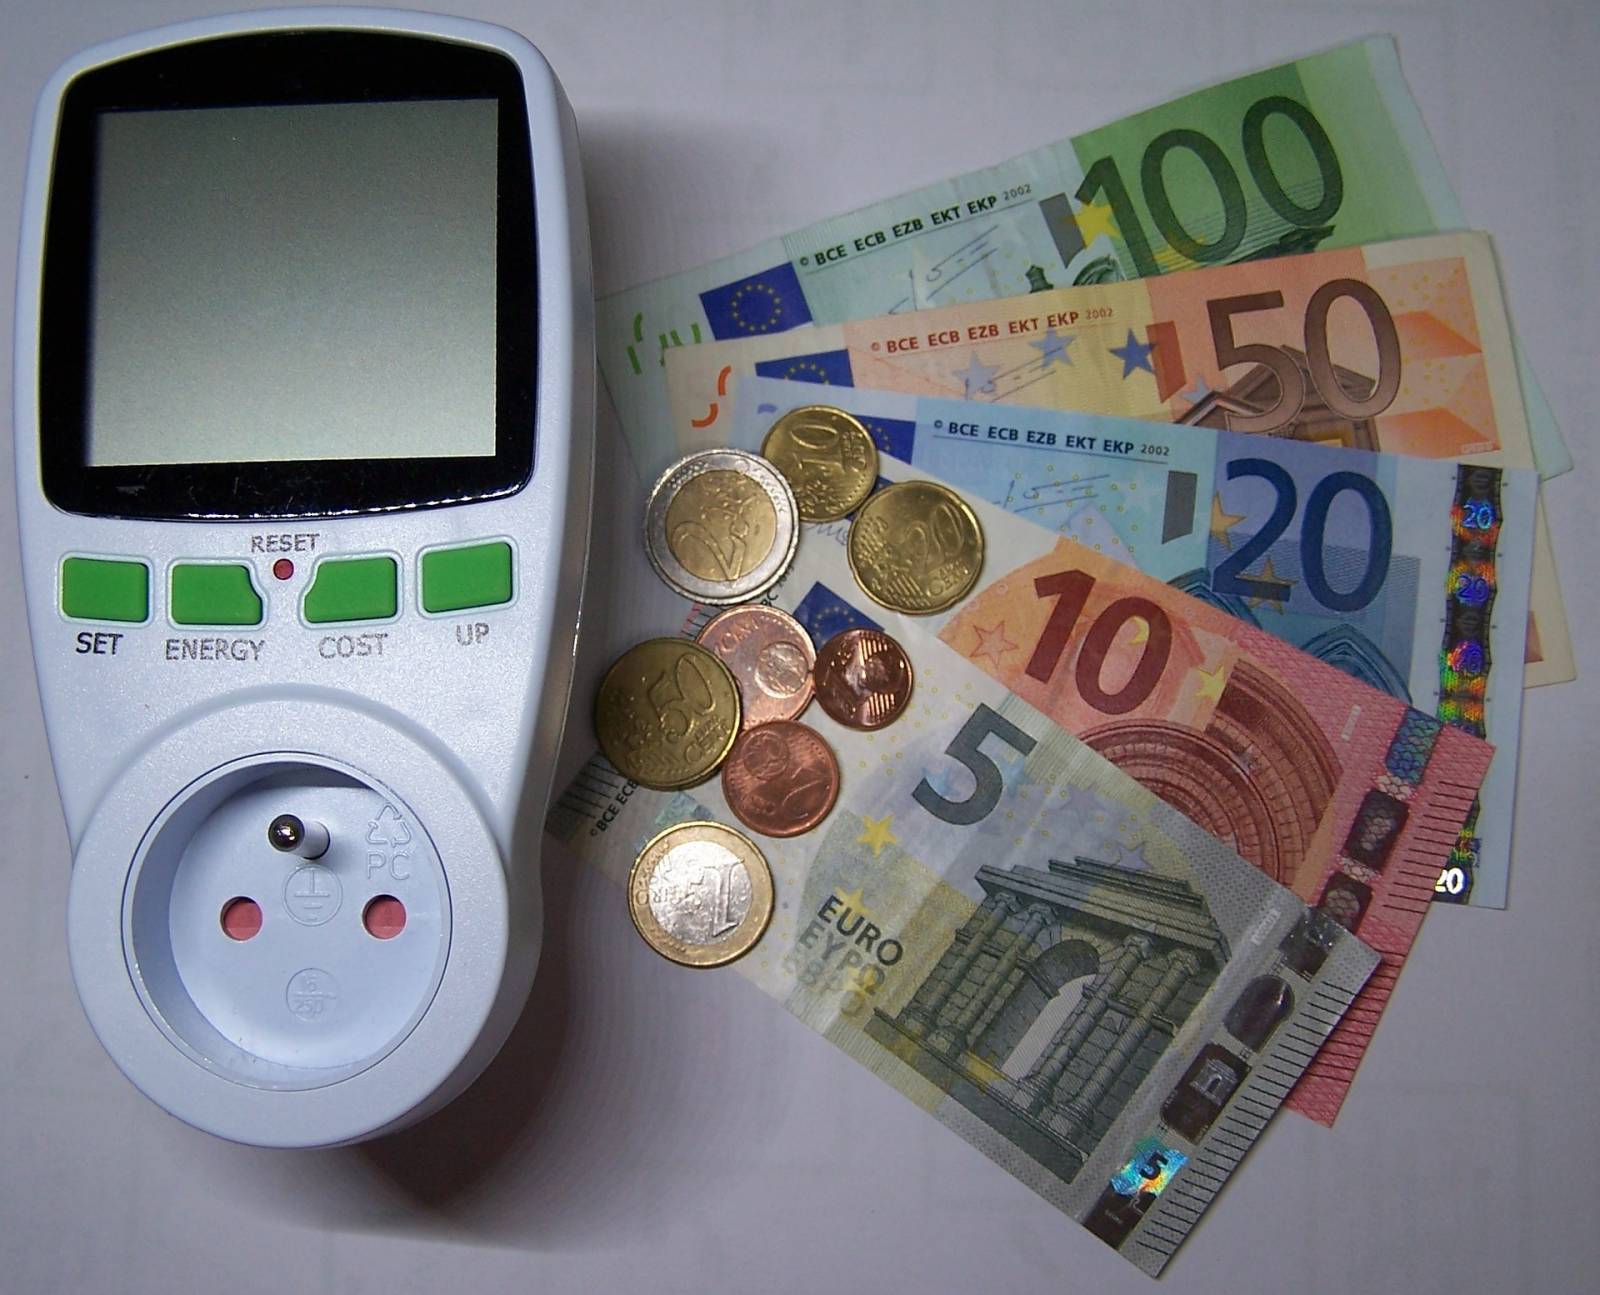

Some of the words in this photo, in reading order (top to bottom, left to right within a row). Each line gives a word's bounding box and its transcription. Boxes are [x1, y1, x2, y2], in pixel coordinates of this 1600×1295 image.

[1074, 95, 1344, 278] 100
[815, 244, 848, 266] BCE
[854, 231, 886, 252] ECB
[892, 218, 924, 239] EZB
[931, 206, 962, 226] EKT
[967, 195, 997, 215] EKP
[1003, 184, 1032, 201] 2002
[886, 336, 919, 354] BCE
[927, 328, 960, 347] ECB
[968, 324, 999, 341] EZB
[1008, 318, 1040, 335] EKT
[1047, 311, 1079, 328] EKP
[1085, 308, 1114, 320] 2002
[1206, 278, 1401, 433] 50
[949, 422, 980, 437] BCE
[987, 426, 1018, 441] ECB
[1026, 430, 1057, 446] EZB
[1066, 435, 1097, 450] EKT
[1103, 439, 1134, 455] EKP
[1140, 444, 1170, 457] 2002
[1463, 503, 1493, 530] 20
[251, 533, 320, 553] RESET
[1211, 457, 1393, 612] 20
[75, 633, 124, 655] SET
[165, 638, 266, 662] ENERGY
[318, 633, 389, 659] COST
[455, 623, 490, 646] UP
[1024, 569, 1172, 715] 10
[911, 702, 1038, 827] 5
[596, 804, 620, 831] BCE
[367, 852, 410, 881] PC
[817, 895, 904, 966] EURO
[1141, 1151, 1169, 1181] 5
